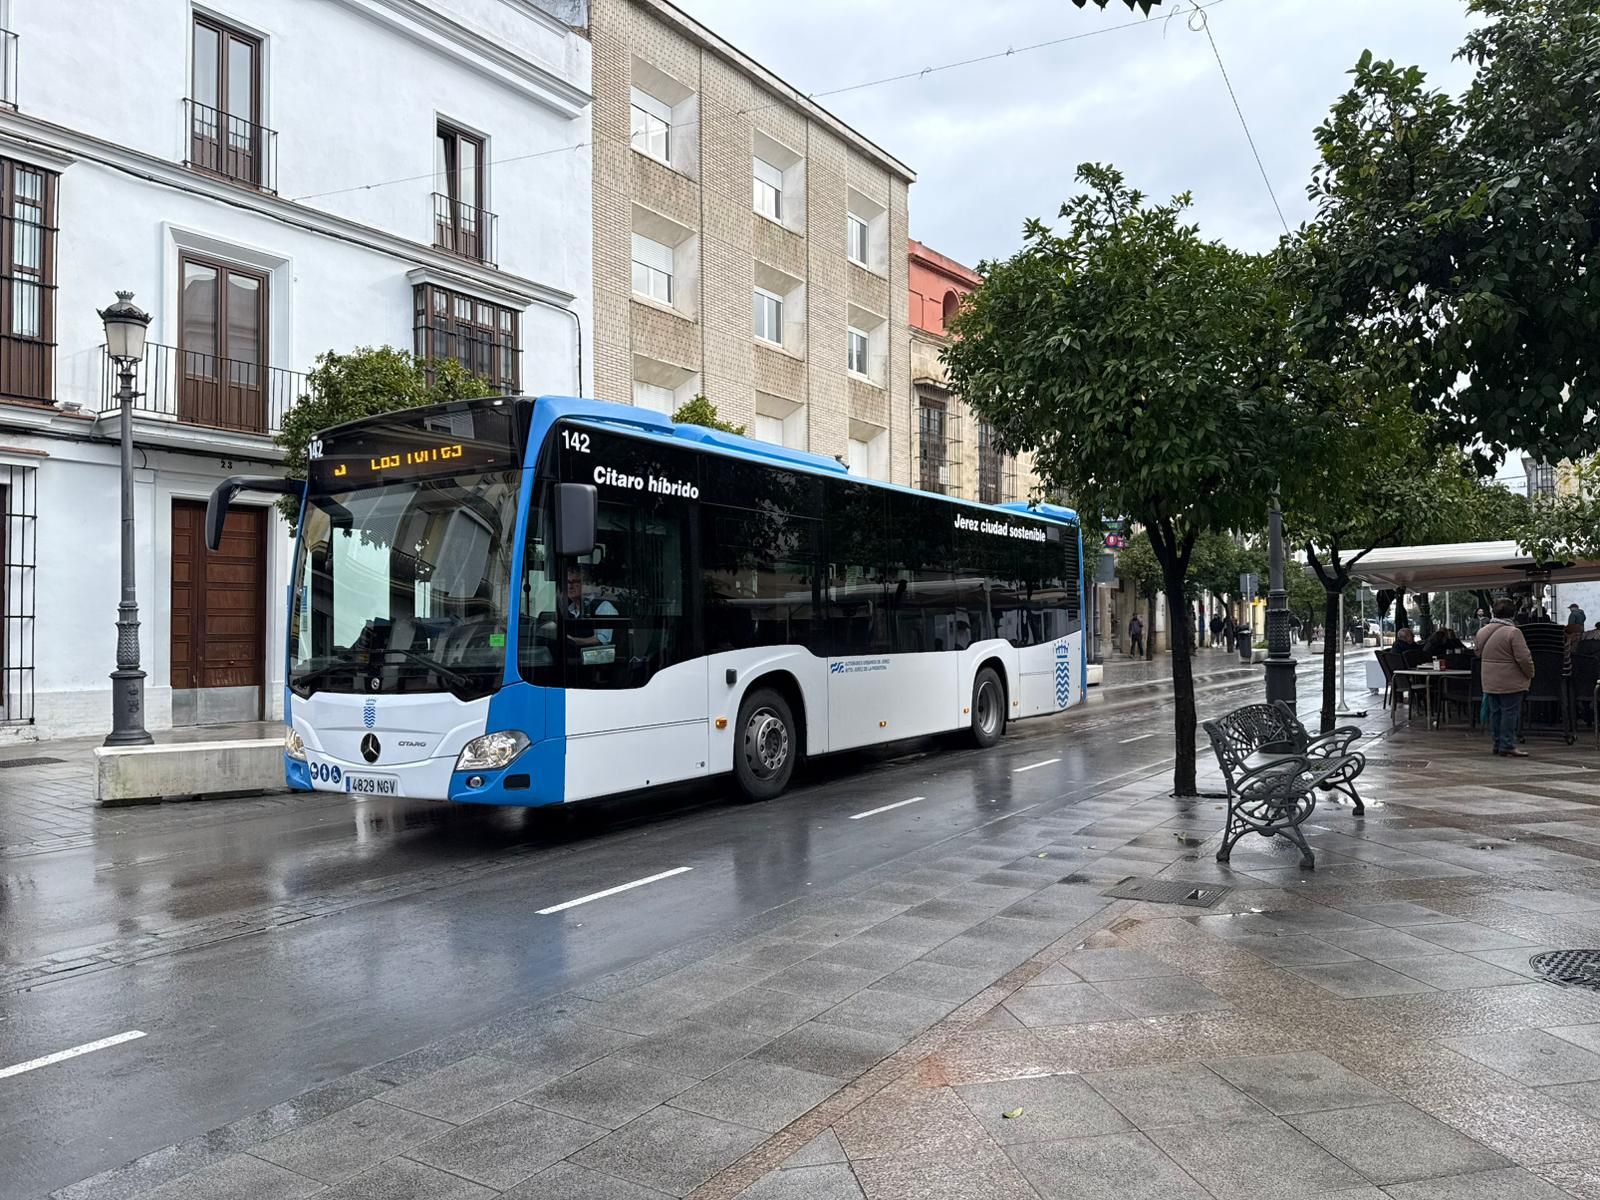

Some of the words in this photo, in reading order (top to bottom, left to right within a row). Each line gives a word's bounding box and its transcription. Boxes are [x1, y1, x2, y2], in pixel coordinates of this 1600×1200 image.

[308, 440, 324, 460] 142
[562, 429, 591, 454] 142
[220, 460, 233, 469] 23
[593, 465, 644, 490] Citaro
[647, 475, 699, 499] híbrido
[954, 513, 979, 532] Jerez
[980, 518, 1008, 537] ciudad
[1009, 525, 1046, 542] sostenible
[352, 778, 375, 793] 4829
[377, 780, 395, 794] NGV
